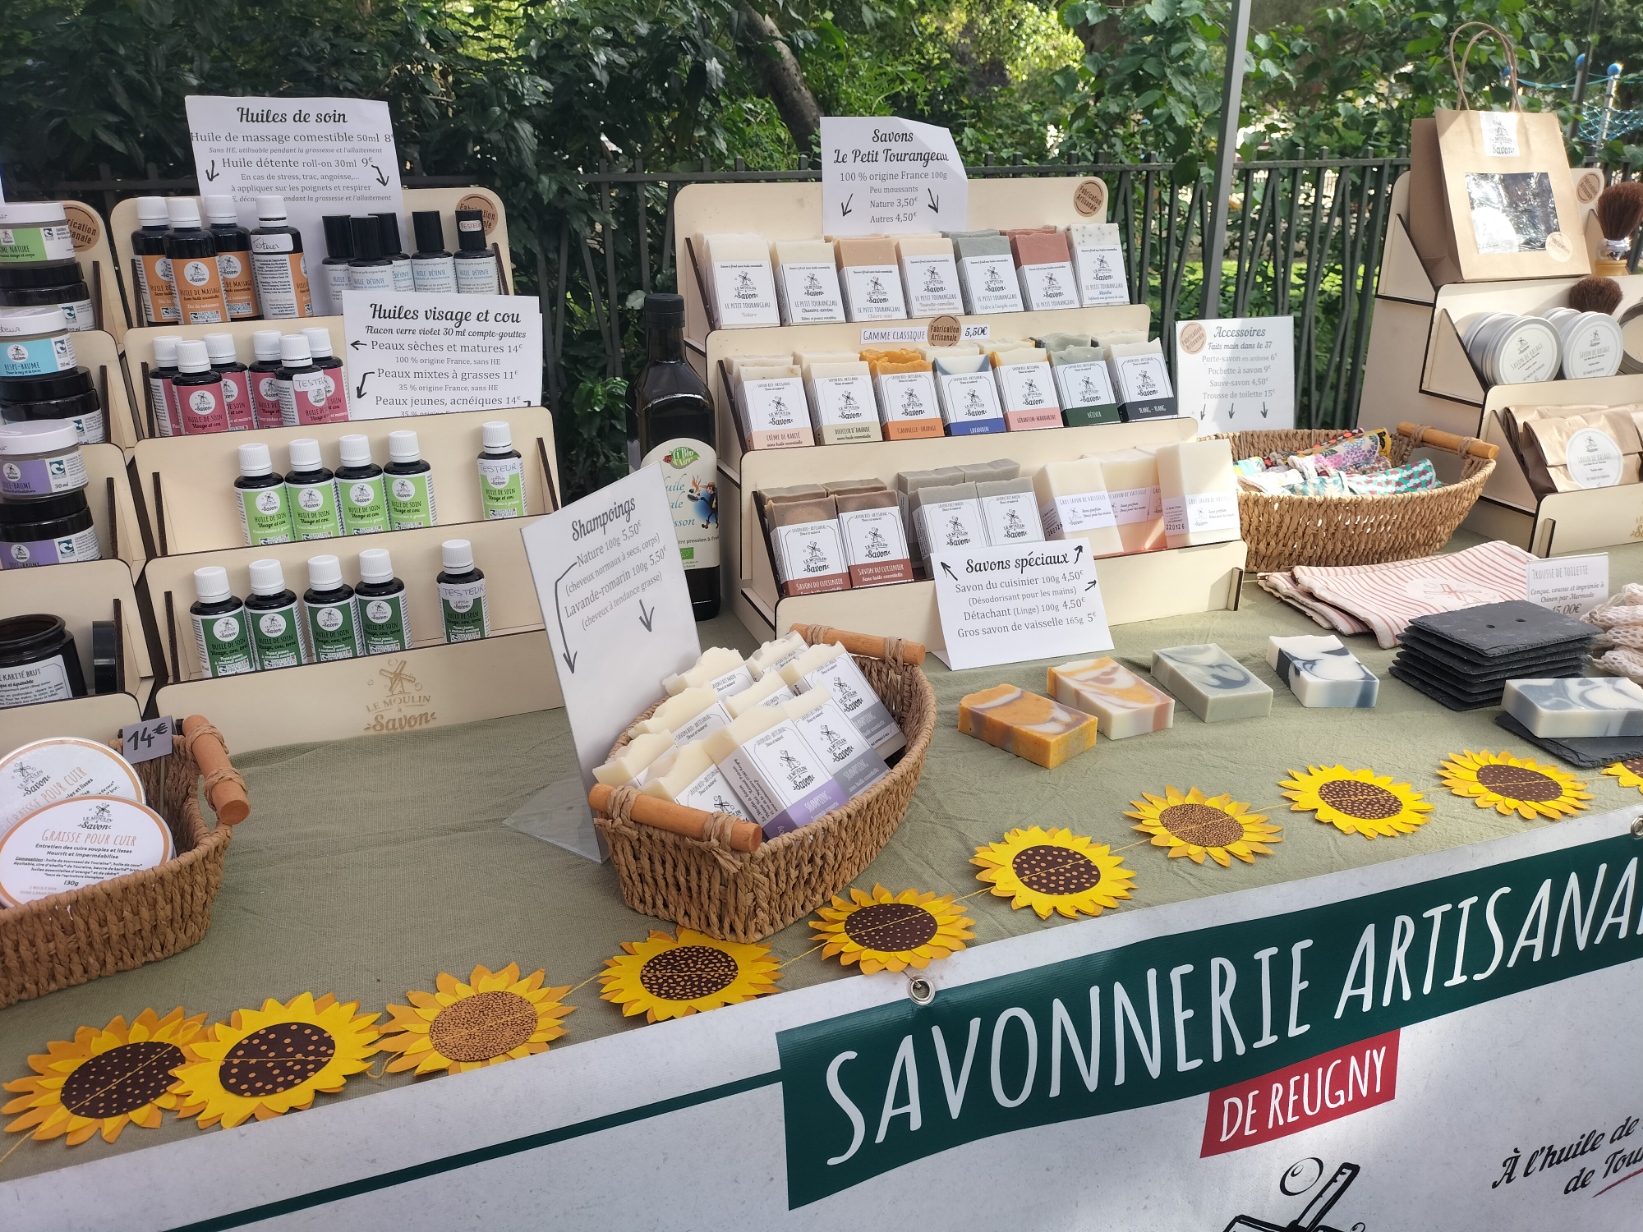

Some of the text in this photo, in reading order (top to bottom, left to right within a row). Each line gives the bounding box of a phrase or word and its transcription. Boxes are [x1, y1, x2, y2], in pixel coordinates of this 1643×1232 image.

[236, 107, 347, 124] Huiles de soin
[191, 132, 221, 142] Huile
[225, 132, 238, 143] de
[242, 133, 291, 145] massage
[294, 132, 353, 143] comestible
[357, 133, 379, 143] 50ml
[872, 129, 913, 143] Savons
[222, 158, 253, 168] Huile
[256, 158, 299, 168] détente
[302, 159, 332, 168] roll-on
[334, 159, 357, 168] 30ml
[834, 149, 949, 168] Le Petit Tourangeau
[840, 170, 947, 183] 100 % origine France 100g
[870, 186, 919, 194] Peu moussants
[870, 200, 895, 209] Nature
[870, 215, 894, 224] Autres
[370, 302, 521, 329] Huiles visage et cou
[365, 326, 394, 336] Flacon
[396, 328, 417, 336] verre
[418, 328, 441, 337] violet
[443, 328, 454, 337] 30
[456, 328, 466, 337] ml
[864, 326, 988, 342] GAMME CLASSIQUE Fabrication 5,50€
[931, 334, 957, 343] Artisanale
[1214, 326, 1266, 339] Accessoires
[371, 340, 405, 351] Peaux
[408, 340, 444, 352] sèches
[447, 342, 457, 353] et
[460, 343, 504, 354] matures
[1202, 356, 1241, 364] Porte-savon
[378, 368, 411, 379] Peaux
[414, 369, 449, 379] mixtes
[452, 370, 458, 380] à
[461, 371, 500, 382] grasses
[1208, 367, 1236, 376] Pochette
[1242, 366, 1262, 374] savon
[1210, 378, 1250, 388] Sauve-savon
[375, 396, 407, 406] Peaux
[410, 396, 448, 408] jeunes,
[451, 396, 502, 408] acnéiques
[1202, 392, 1228, 400] Trousse
[1230, 390, 1238, 399] de
[1239, 390, 1262, 399] toilette
[572, 498, 636, 542] Shampoings
[576, 544, 604, 568] Nature
[606, 537, 622, 552] 100g
[565, 570, 595, 598] (cheveux
[594, 556, 622, 581] normaux
[642, 532, 661, 555] corps)
[966, 551, 1069, 575] Savons spéciaux
[1556, 568, 1562, 578] DE
[564, 570, 631, 620] Lavande-romarin
[632, 561, 649, 578] 100g
[956, 582, 984, 594] Savon
[986, 580, 998, 591] du
[1000, 577, 1039, 589] cuisinier
[1042, 575, 1061, 587] 100g
[581, 604, 610, 631] (cheveux
[613, 585, 641, 608] tendance
[641, 571, 663, 594] grasse)
[968, 586, 1077, 608] (Désodorisant pour les mains)
[964, 609, 1011, 622] Détachant
[1013, 606, 1040, 618] (Linge)
[1042, 604, 1060, 614] 100g
[1552, 603, 1582, 615] 1500€
[958, 628, 980, 639] Gros
[982, 626, 1009, 637] savon
[1011, 622, 1023, 632] de
[1024, 618, 1064, 630] vaisselle
[1066, 616, 1084, 628] 165g
[366, 695, 431, 713] LE MOULIN
[372, 712, 431, 732] Savon
[126, 722, 170, 752] 14€
[79, 821, 109, 832] Savon
[42, 829, 137, 847] GRAISSE POUR CUIR
[826, 857, 1643, 1167] SAVONNERIE ARTISANA
[1219, 1045, 1389, 1143] DE REUGNY
[1491, 1115, 1640, 1189] À l'huile de
[1564, 1166, 1595, 1195] de
